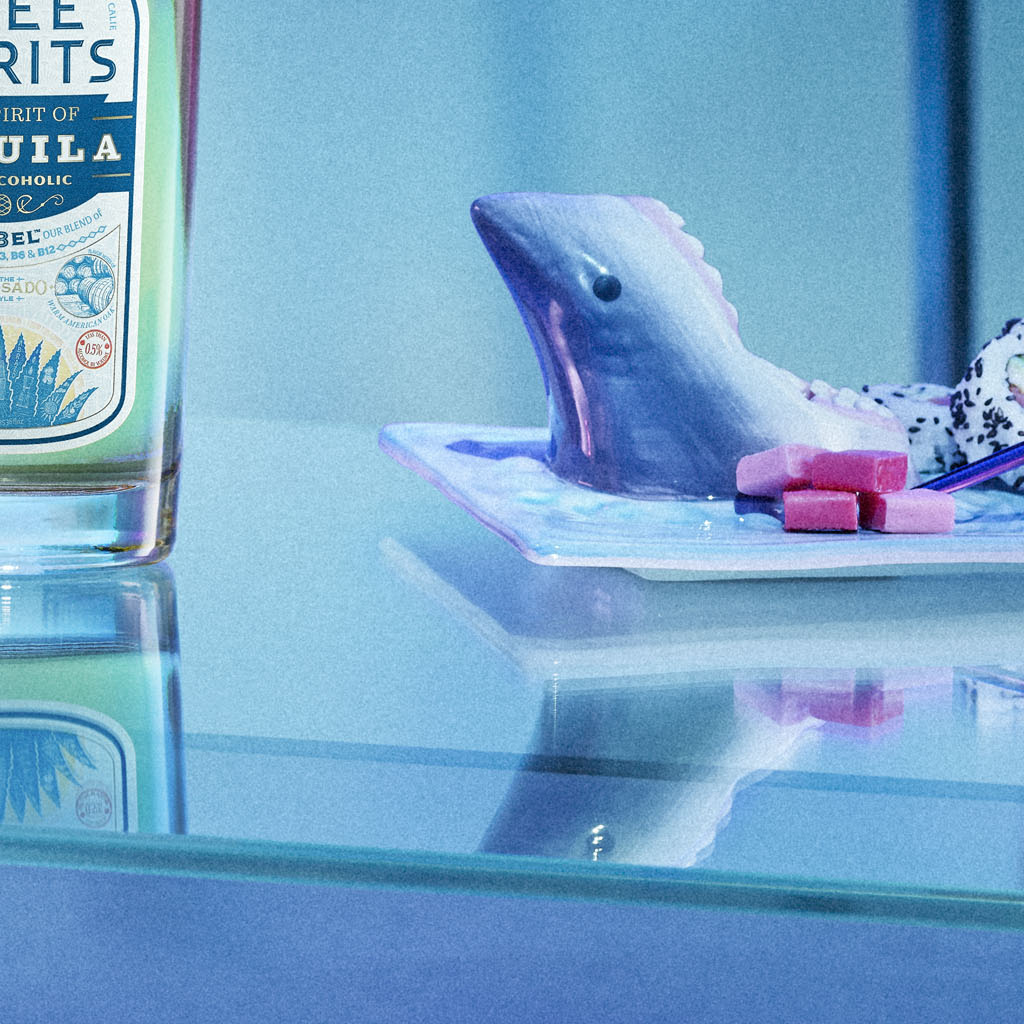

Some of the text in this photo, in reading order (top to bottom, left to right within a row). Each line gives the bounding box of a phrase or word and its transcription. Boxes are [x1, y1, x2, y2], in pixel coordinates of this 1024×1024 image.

[52, 106, 80, 122] OF
[42, 227, 63, 239] OUR
[64, 215, 93, 234] BLEND
[93, 207, 103, 220] of
[10, 251, 26, 260] B6
[27, 249, 36, 259] &
[37, 245, 56, 257] B12
[84, 342, 103, 356] 0.5%
